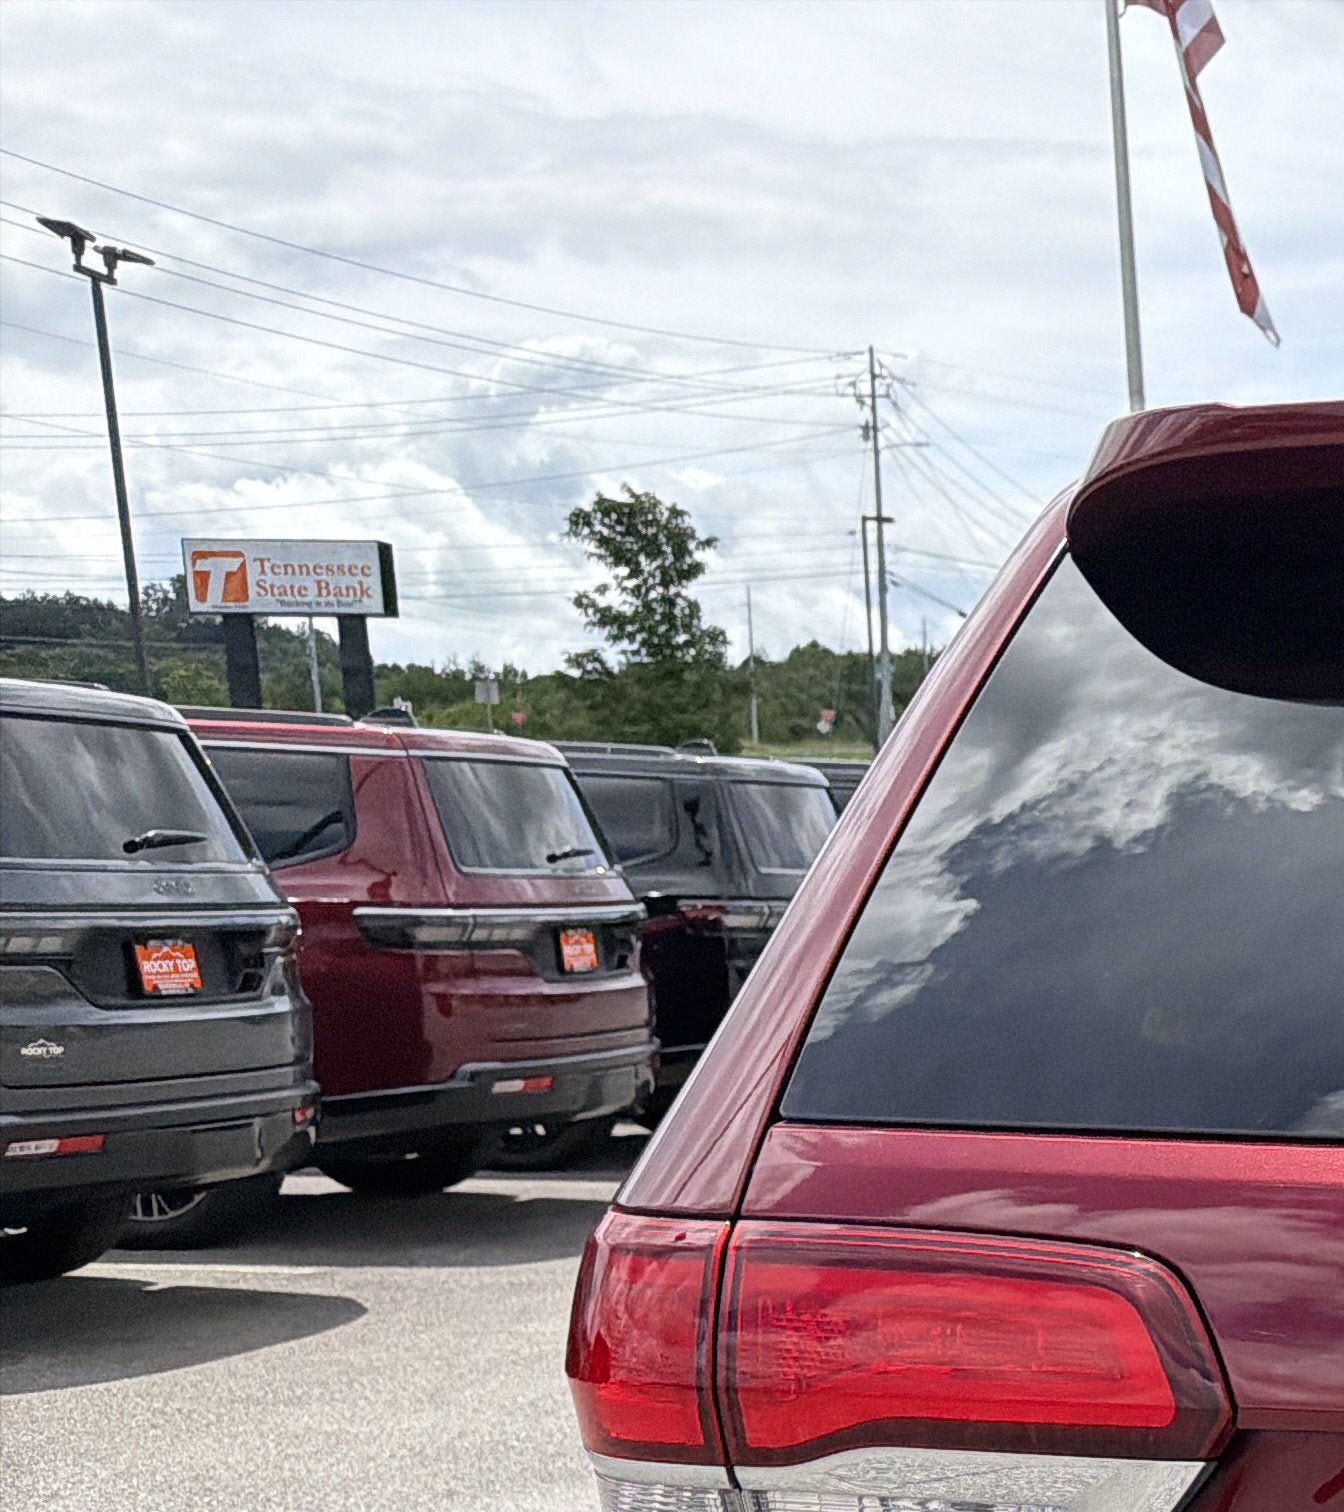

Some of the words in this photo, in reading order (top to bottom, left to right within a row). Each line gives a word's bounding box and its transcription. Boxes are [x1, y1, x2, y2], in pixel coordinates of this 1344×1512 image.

[253, 557, 372, 577] Tennessee
[256, 579, 309, 598] State
[315, 578, 373, 599] Bank
